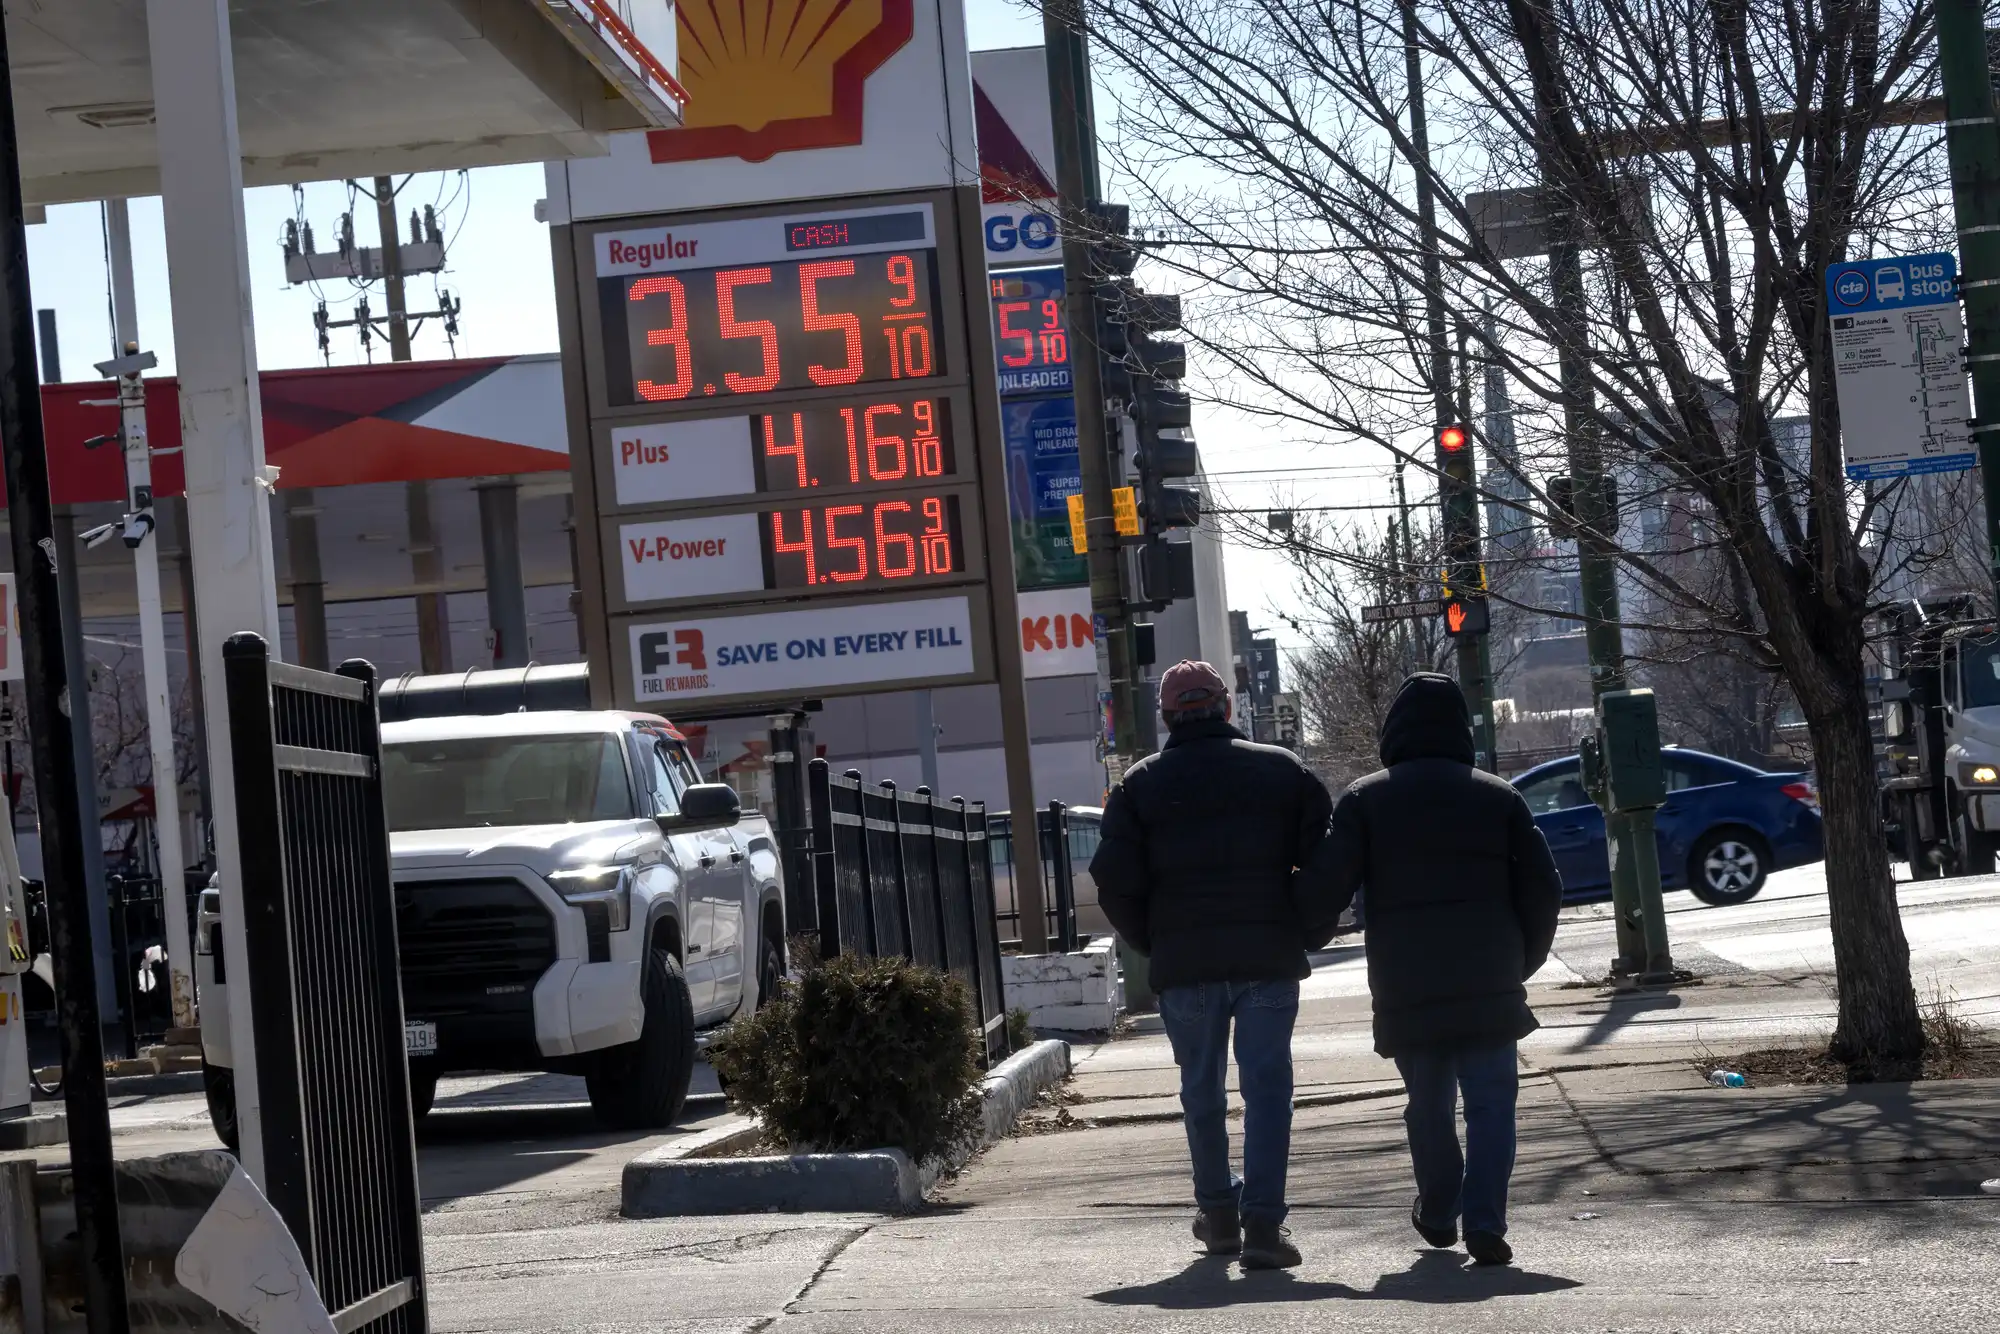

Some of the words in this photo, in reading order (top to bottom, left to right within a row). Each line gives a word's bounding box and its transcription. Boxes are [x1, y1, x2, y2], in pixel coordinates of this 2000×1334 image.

[791, 223, 850, 248] CASH
[608, 233, 699, 269] Regular
[1909, 263, 1944, 279] bus
[1840, 282, 1864, 295] cta
[1911, 280, 1953, 299] stop
[628, 260, 864, 401] 3.55
[1856, 318, 1881, 327] Ashland
[1844, 351, 1856, 360] X9
[1034, 428, 1053, 440] MID
[1055, 427, 1078, 438] GRA
[620, 439, 670, 466] Plus
[763, 404, 908, 487] 4.16
[1037, 437, 1080, 451] UNLEADE
[1049, 477, 1081, 489] SUPER
[628, 536, 727, 564] V-Power
[772, 500, 917, 585] 4.56
[1053, 536, 1075, 547] DIES
[716, 641, 779, 667] SAVE
[786, 637, 827, 661] ON
[834, 629, 909, 657] EVERY
[915, 626, 963, 650] FILL
[642, 678, 665, 694] FUEL
[665, 673, 709, 692] REWARDS
